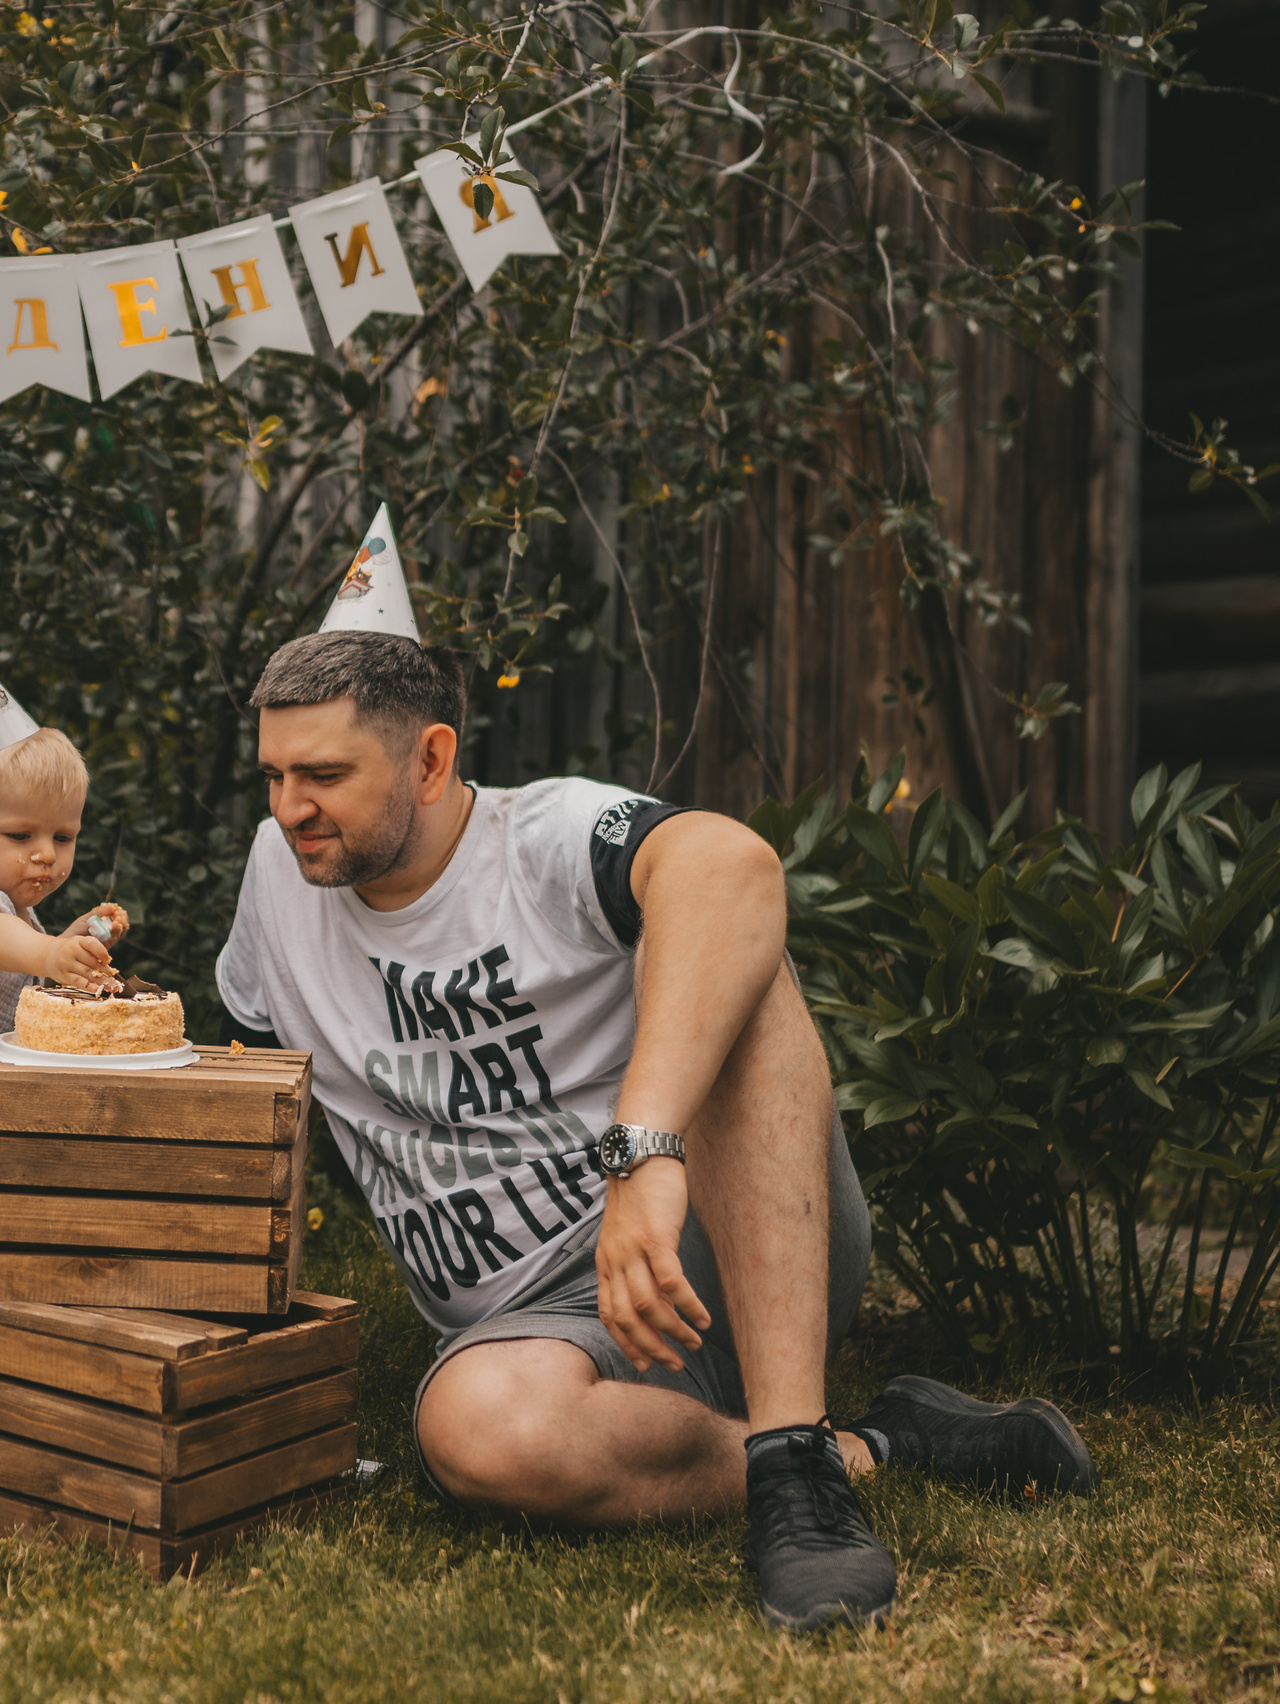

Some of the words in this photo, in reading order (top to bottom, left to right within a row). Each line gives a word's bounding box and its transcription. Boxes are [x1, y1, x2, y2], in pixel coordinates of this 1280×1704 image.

[368, 943, 537, 1043] MAKE
[365, 1024, 552, 1124] SMART
[376, 1188, 525, 1301] YOUR
